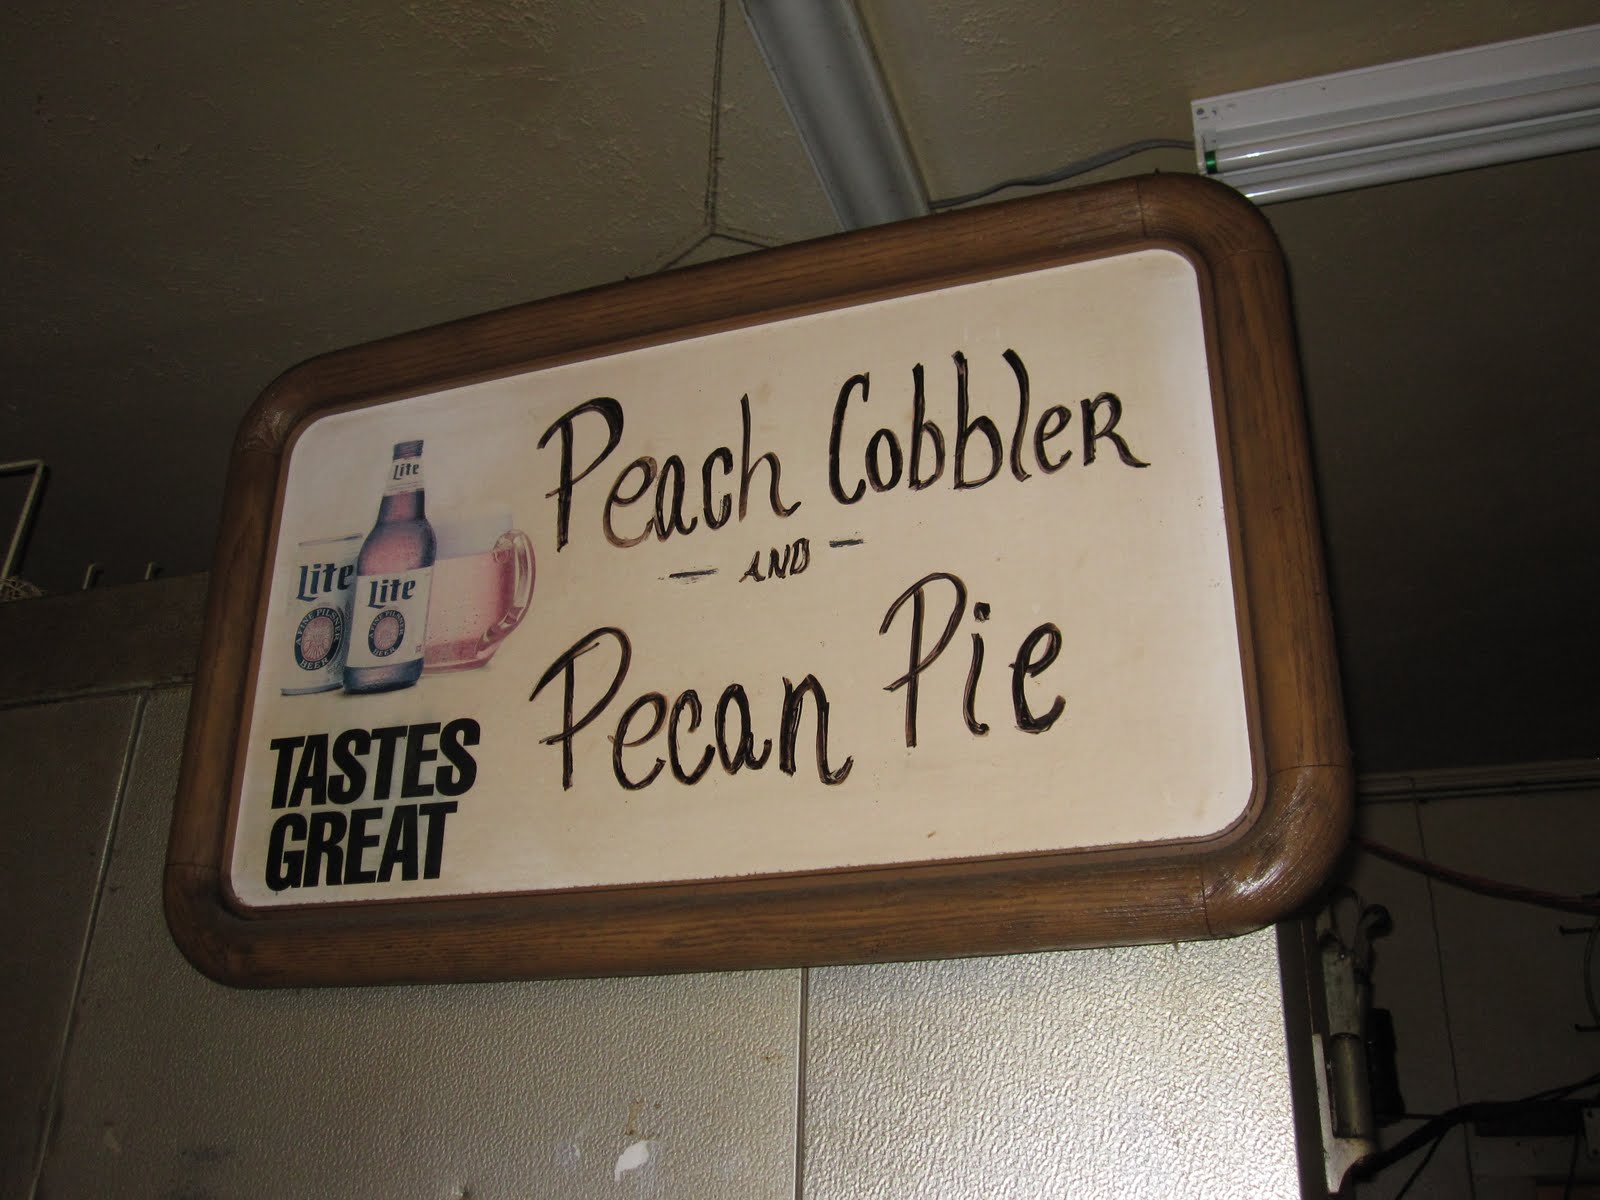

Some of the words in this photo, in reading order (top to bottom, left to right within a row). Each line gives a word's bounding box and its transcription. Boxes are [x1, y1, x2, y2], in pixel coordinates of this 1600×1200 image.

[393, 463, 420, 481] Lite
[537, 393, 801, 552] Peach
[296, 562, 354, 602] Lite
[368, 579, 416, 609] Lite
[299, 613, 316, 635] FINE
[316, 608, 342, 643] PILSNER
[300, 657, 329, 671] BEER
[373, 646, 396, 657] BEER
[529, 627, 854, 791] Pecan
[879, 572, 1066, 748] Pie
[270, 718, 481, 809] TASTES
[265, 801, 458, 892] GREAT
